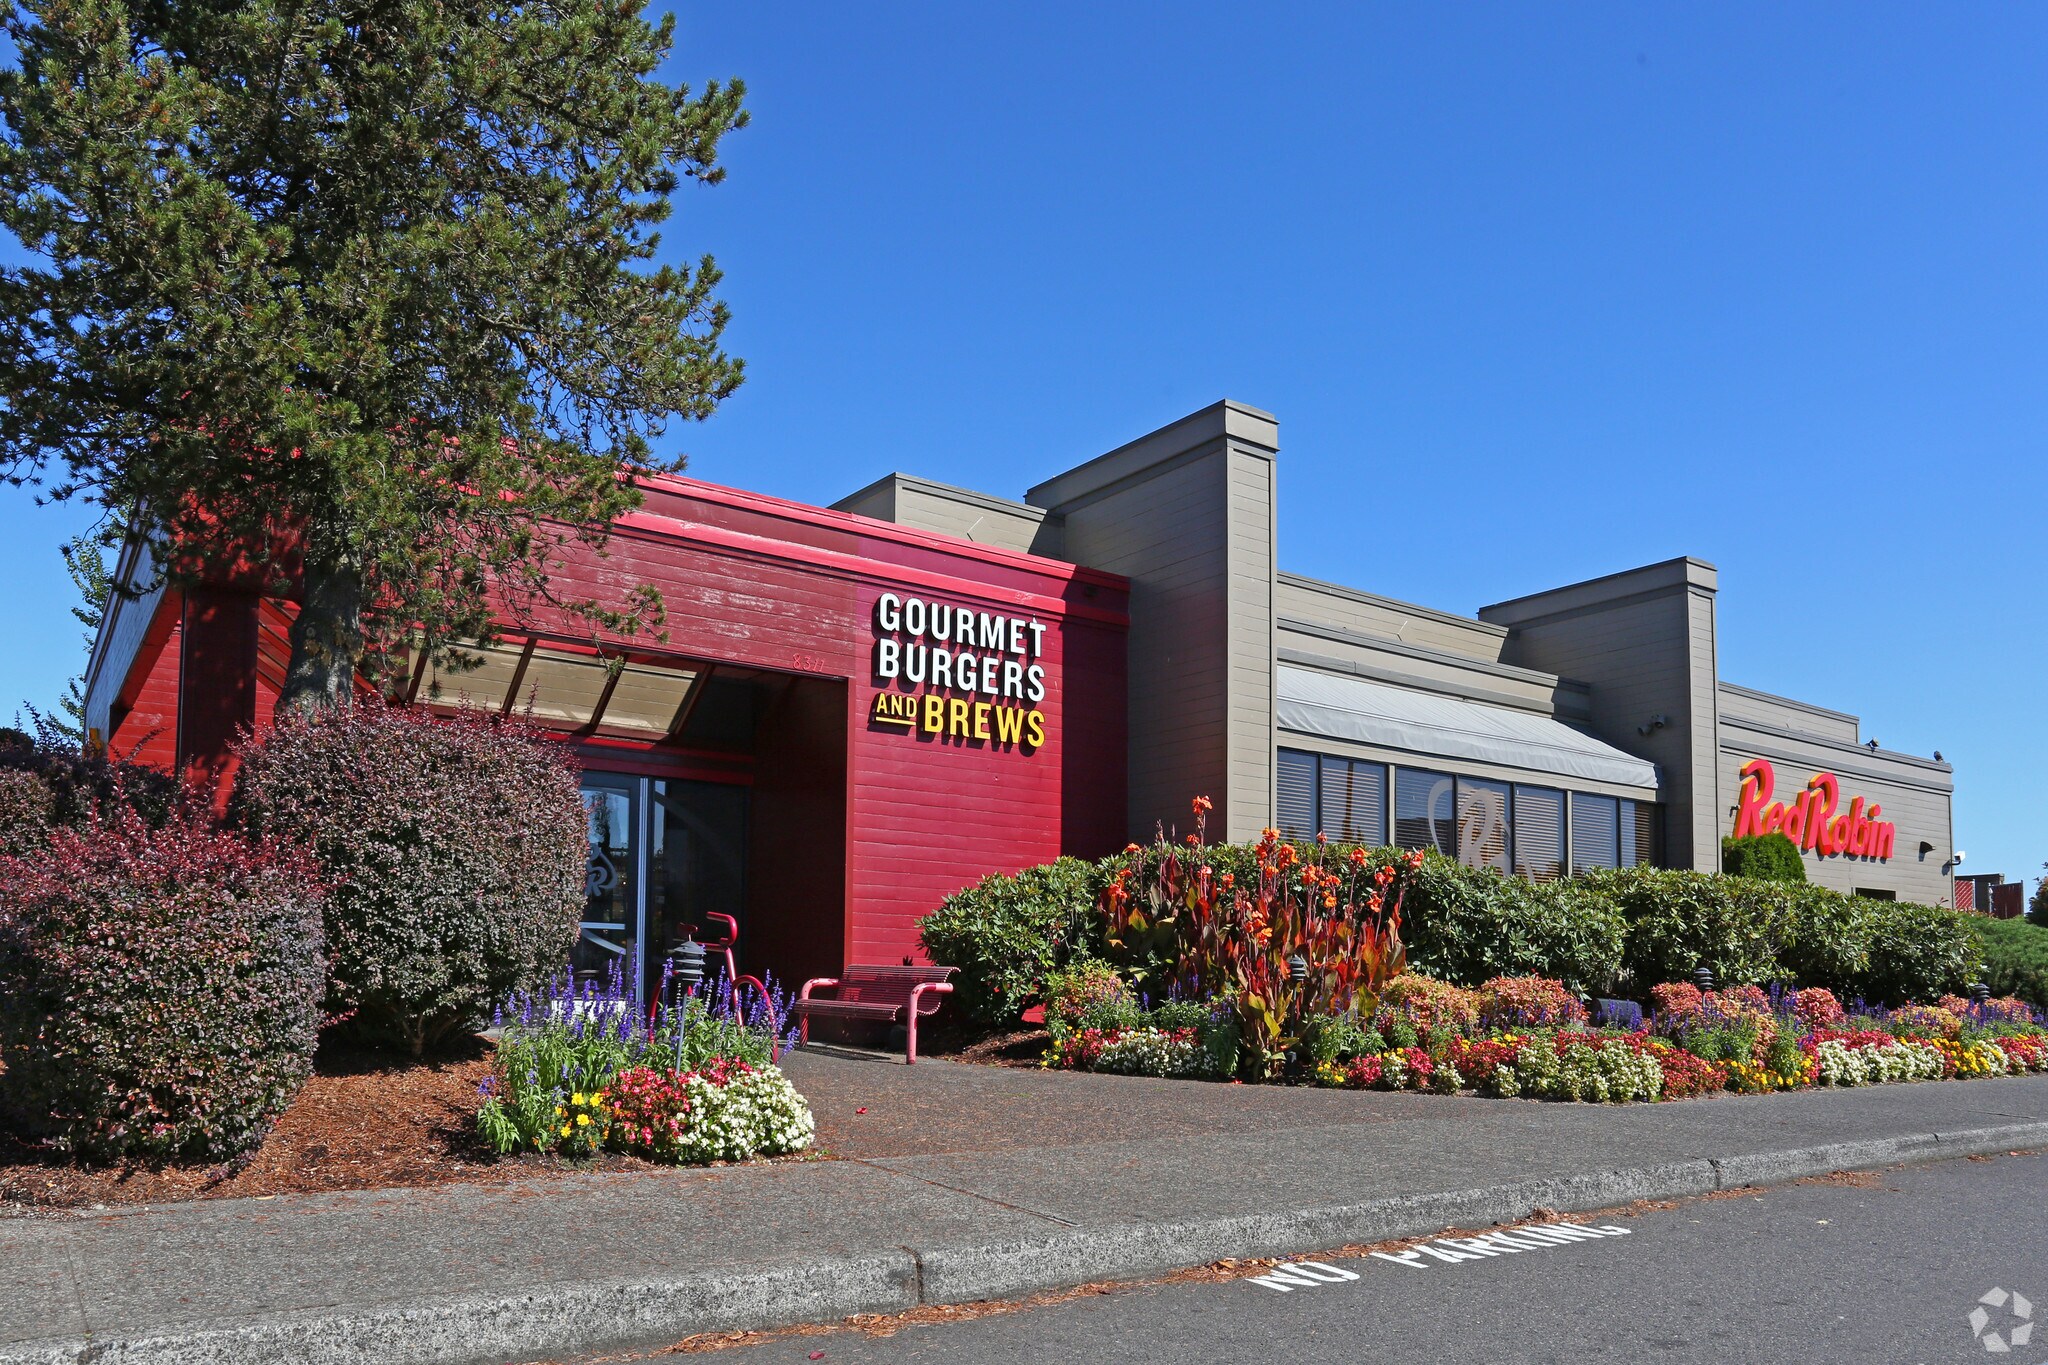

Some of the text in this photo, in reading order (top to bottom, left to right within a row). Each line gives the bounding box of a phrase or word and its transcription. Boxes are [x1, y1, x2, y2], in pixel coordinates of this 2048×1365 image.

[879, 592, 1047, 658] GOURMET
[879, 638, 1046, 702] BURGERS
[876, 692, 1046, 747] AND BREWS
[1245, 1221, 1632, 1292] NO PARKING
